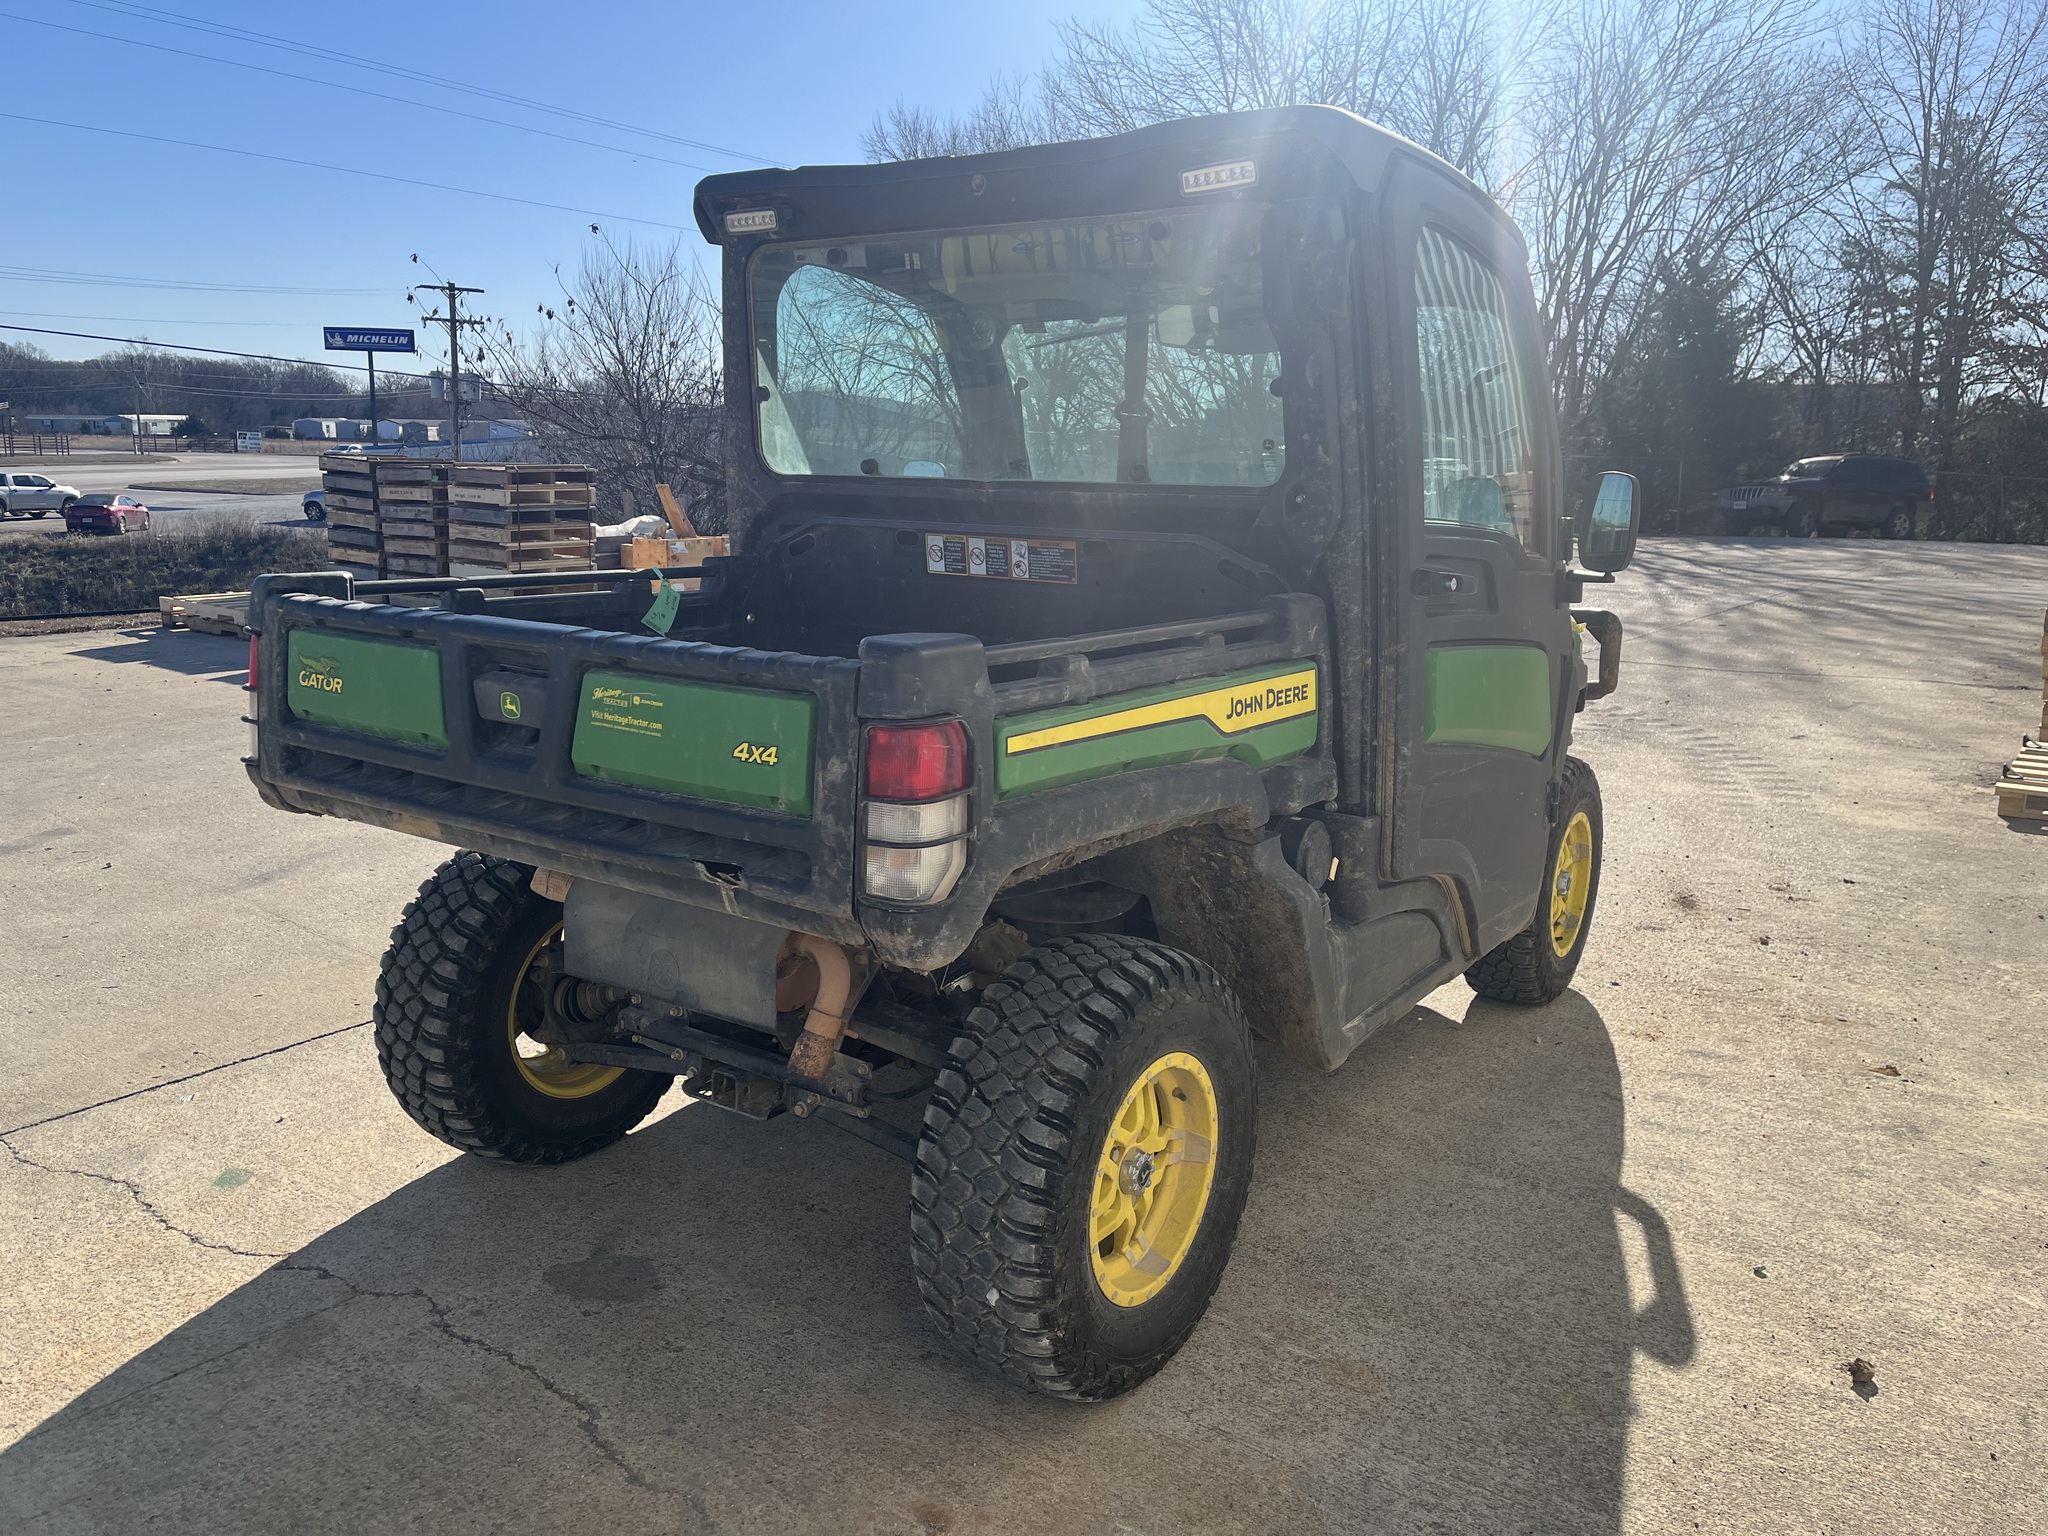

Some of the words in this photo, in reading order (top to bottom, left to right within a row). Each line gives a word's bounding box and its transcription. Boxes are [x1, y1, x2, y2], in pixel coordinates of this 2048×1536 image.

[346, 334, 409, 344] MICHELIN
[299, 670, 343, 694] GATOR
[591, 687, 622, 700] Heritage
[1226, 694, 1263, 720] JOHN
[1266, 683, 1309, 710] DEERE
[603, 697, 628, 708] TRACTOR
[591, 709, 604, 720] Visit
[604, 712, 663, 730] HeritageTractor.com
